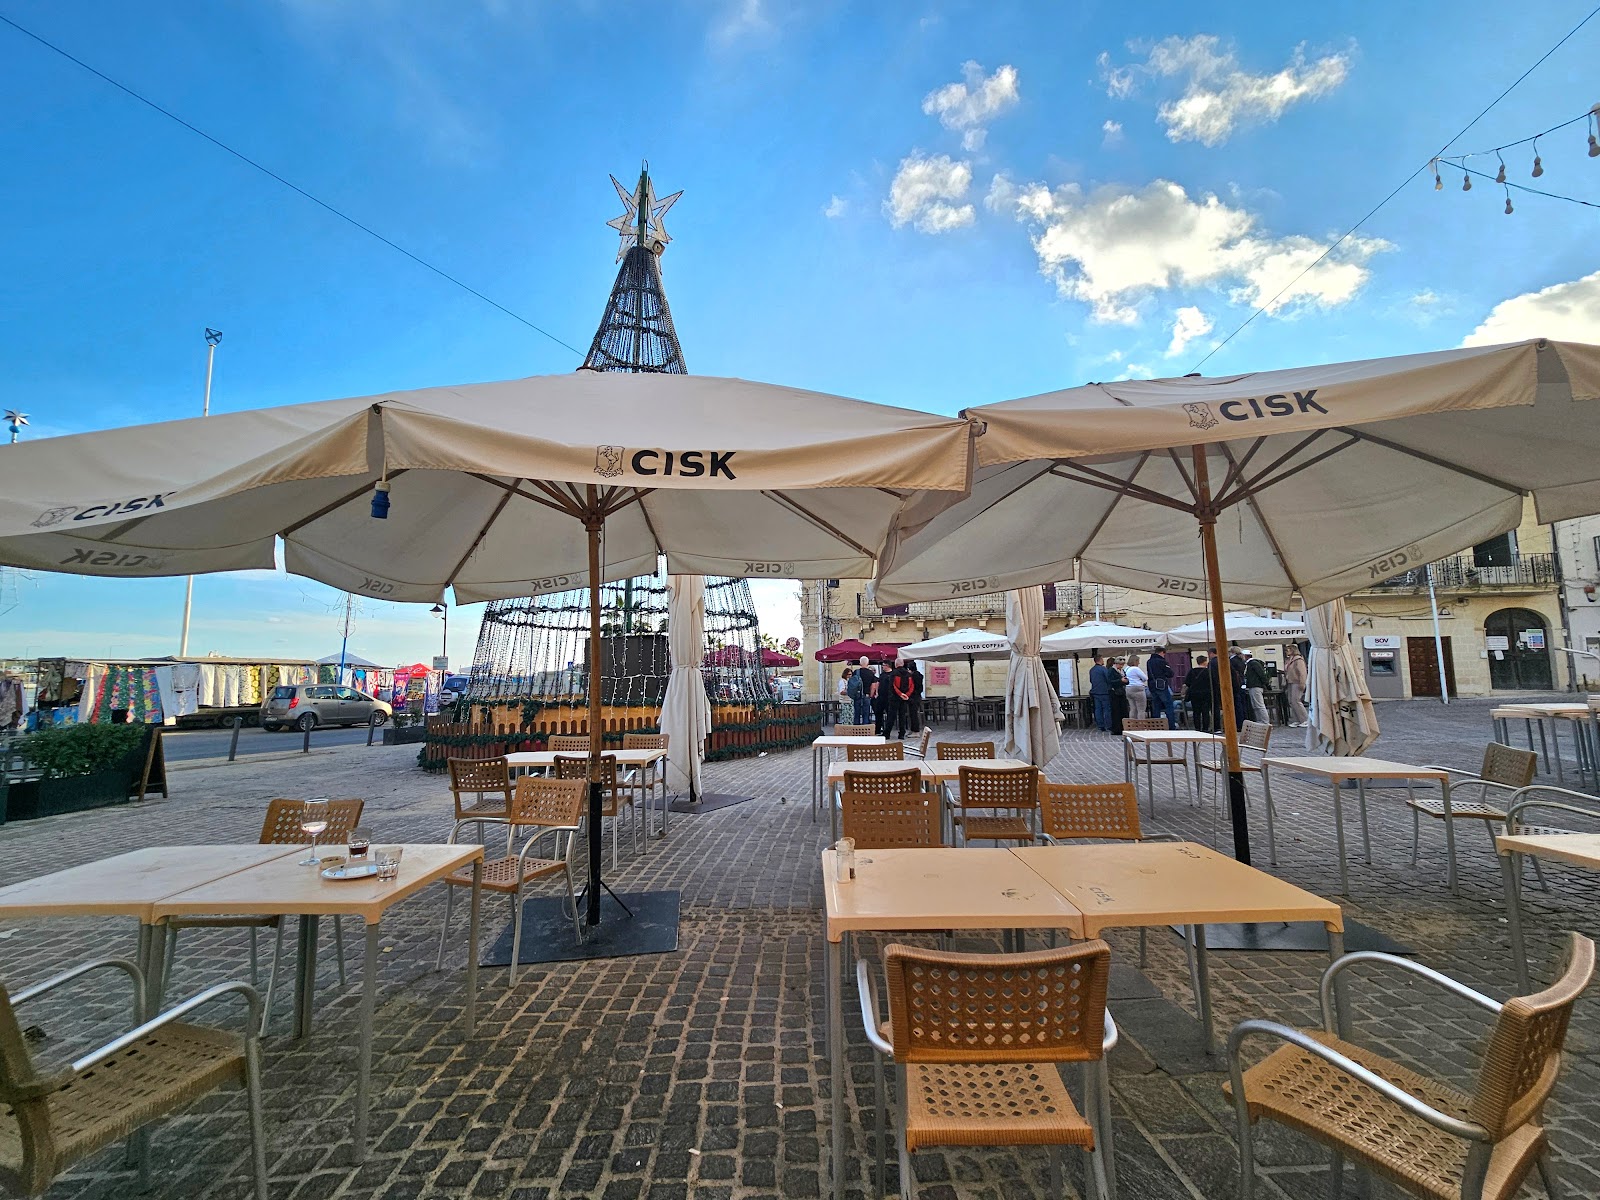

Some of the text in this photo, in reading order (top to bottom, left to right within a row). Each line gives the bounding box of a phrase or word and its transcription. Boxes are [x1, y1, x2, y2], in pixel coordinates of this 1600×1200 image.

[1219, 389, 1329, 421] CISK
[631, 449, 737, 480] CISK
[73, 491, 178, 521] CISK
